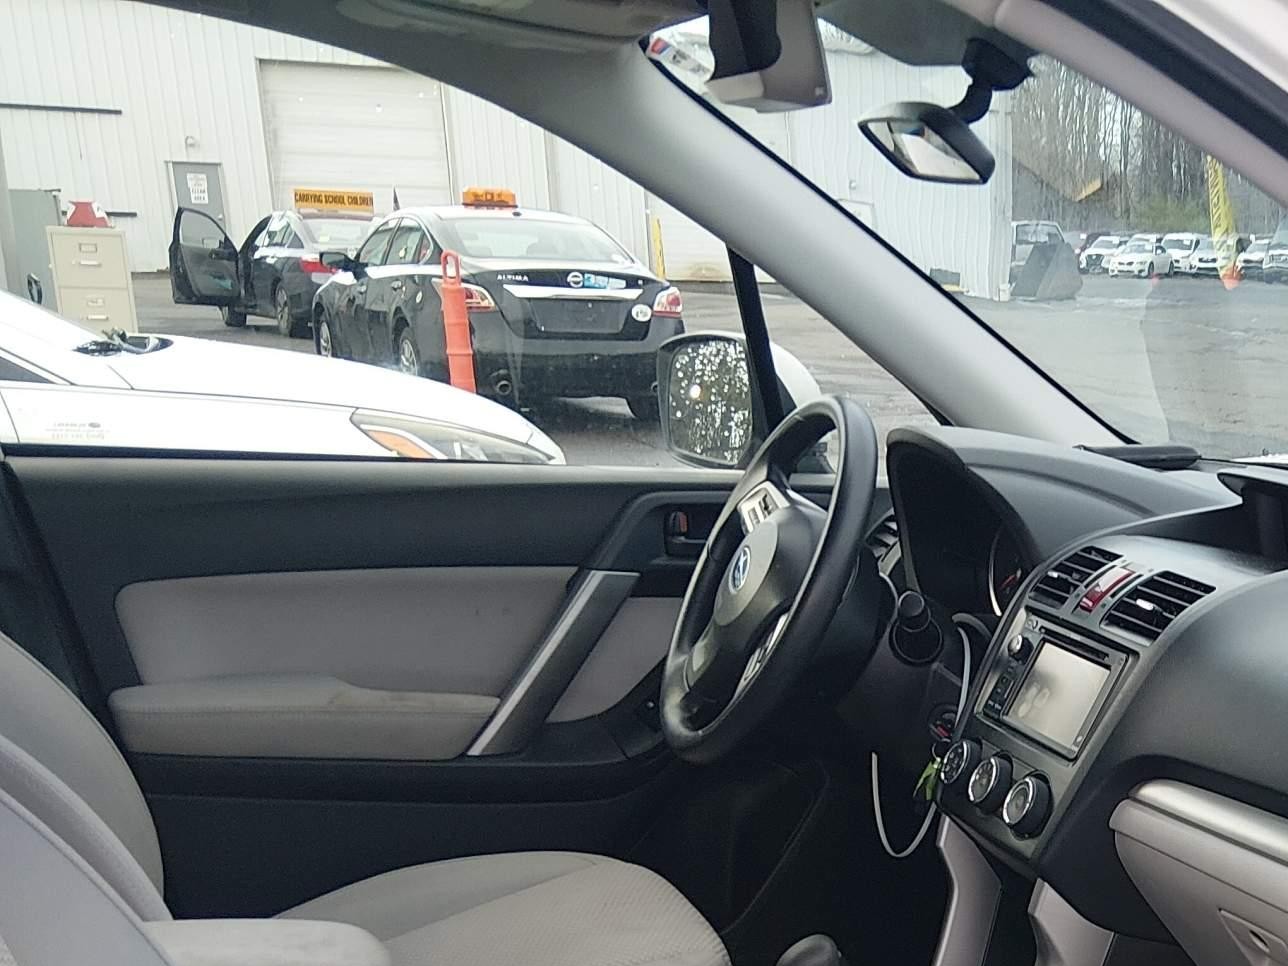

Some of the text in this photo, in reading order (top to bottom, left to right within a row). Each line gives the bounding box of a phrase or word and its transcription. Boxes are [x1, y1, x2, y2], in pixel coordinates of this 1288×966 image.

[294, 191, 374, 207] CARRYING SCHOOL CHILDREN
[497, 274, 529, 282] ALTIMA
